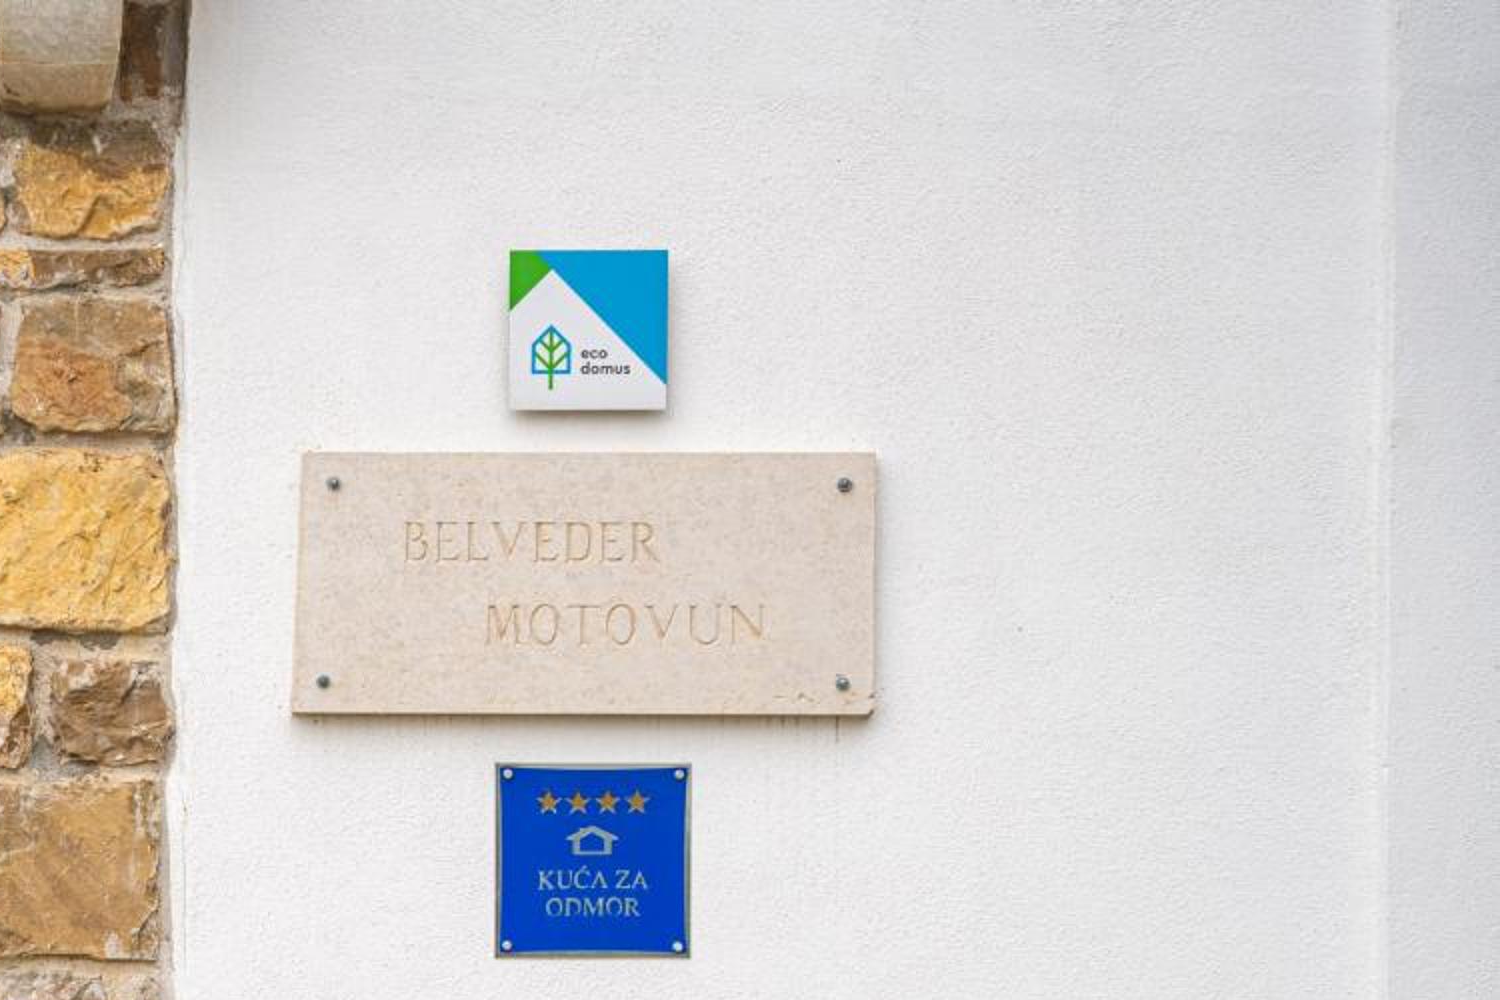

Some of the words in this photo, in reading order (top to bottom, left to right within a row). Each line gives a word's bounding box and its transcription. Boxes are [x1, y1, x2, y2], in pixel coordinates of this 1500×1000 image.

[581, 349, 608, 359] eco
[581, 361, 631, 374] domus
[403, 520, 660, 563] BELVEDER
[483, 604, 767, 647] MOTOVUN
[538, 865, 608, 891] KUĆA
[615, 869, 648, 890] ZA
[546, 896, 640, 917] ODMOR
